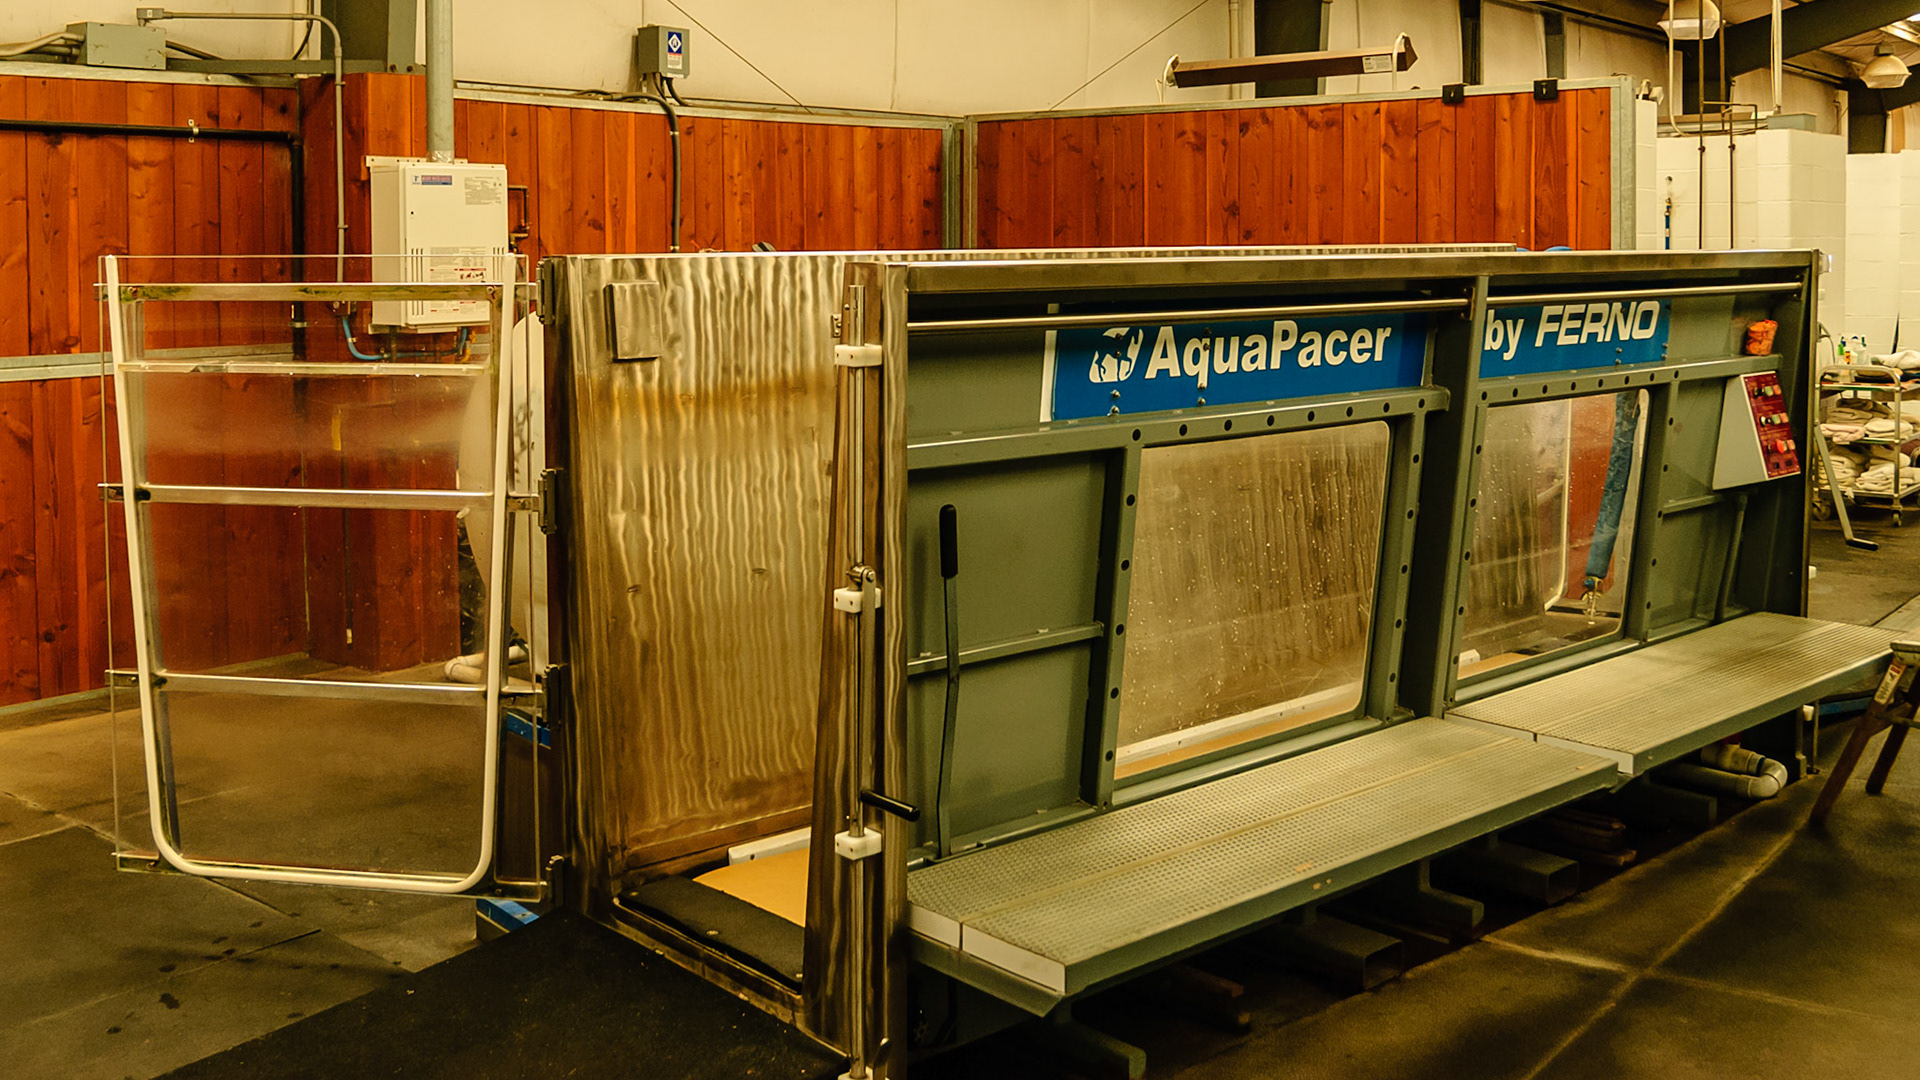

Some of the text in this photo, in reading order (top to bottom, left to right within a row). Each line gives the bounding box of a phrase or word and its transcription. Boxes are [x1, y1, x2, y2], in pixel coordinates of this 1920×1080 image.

[1144, 301, 1660, 388] AquaPacer by FERNO
